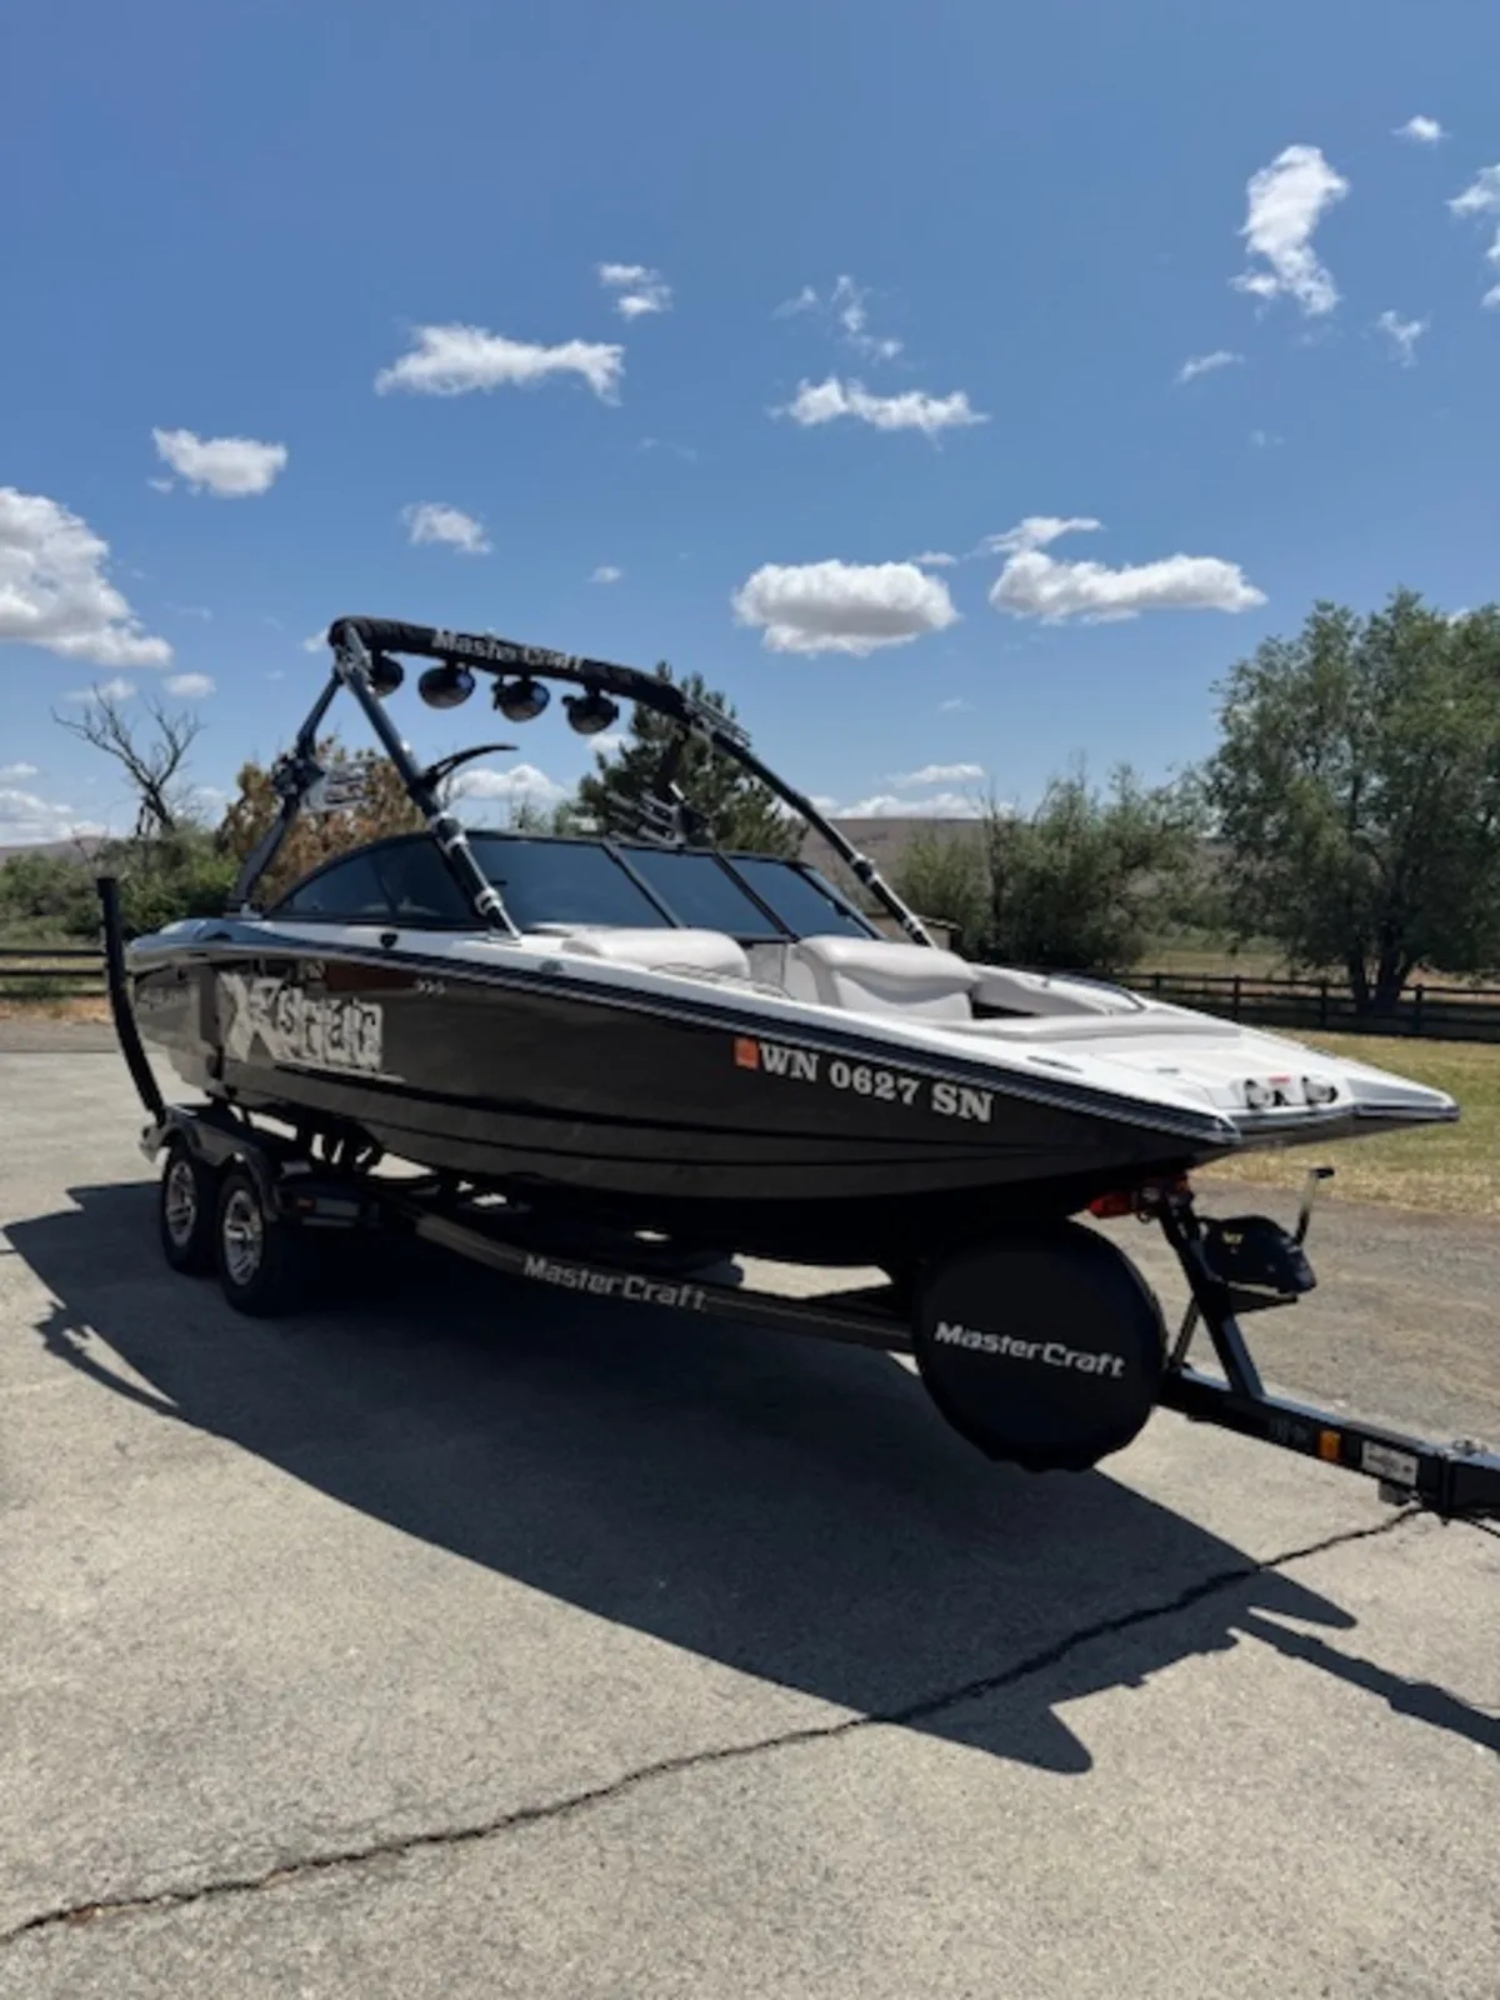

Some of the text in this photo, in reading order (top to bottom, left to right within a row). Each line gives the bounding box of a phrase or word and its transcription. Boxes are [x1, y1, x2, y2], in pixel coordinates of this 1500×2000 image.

[759, 1043, 994, 1123] WN 0627 SN
[523, 1255, 707, 1311] MasterCraft
[934, 1321, 1125, 1377] MasterCraft
